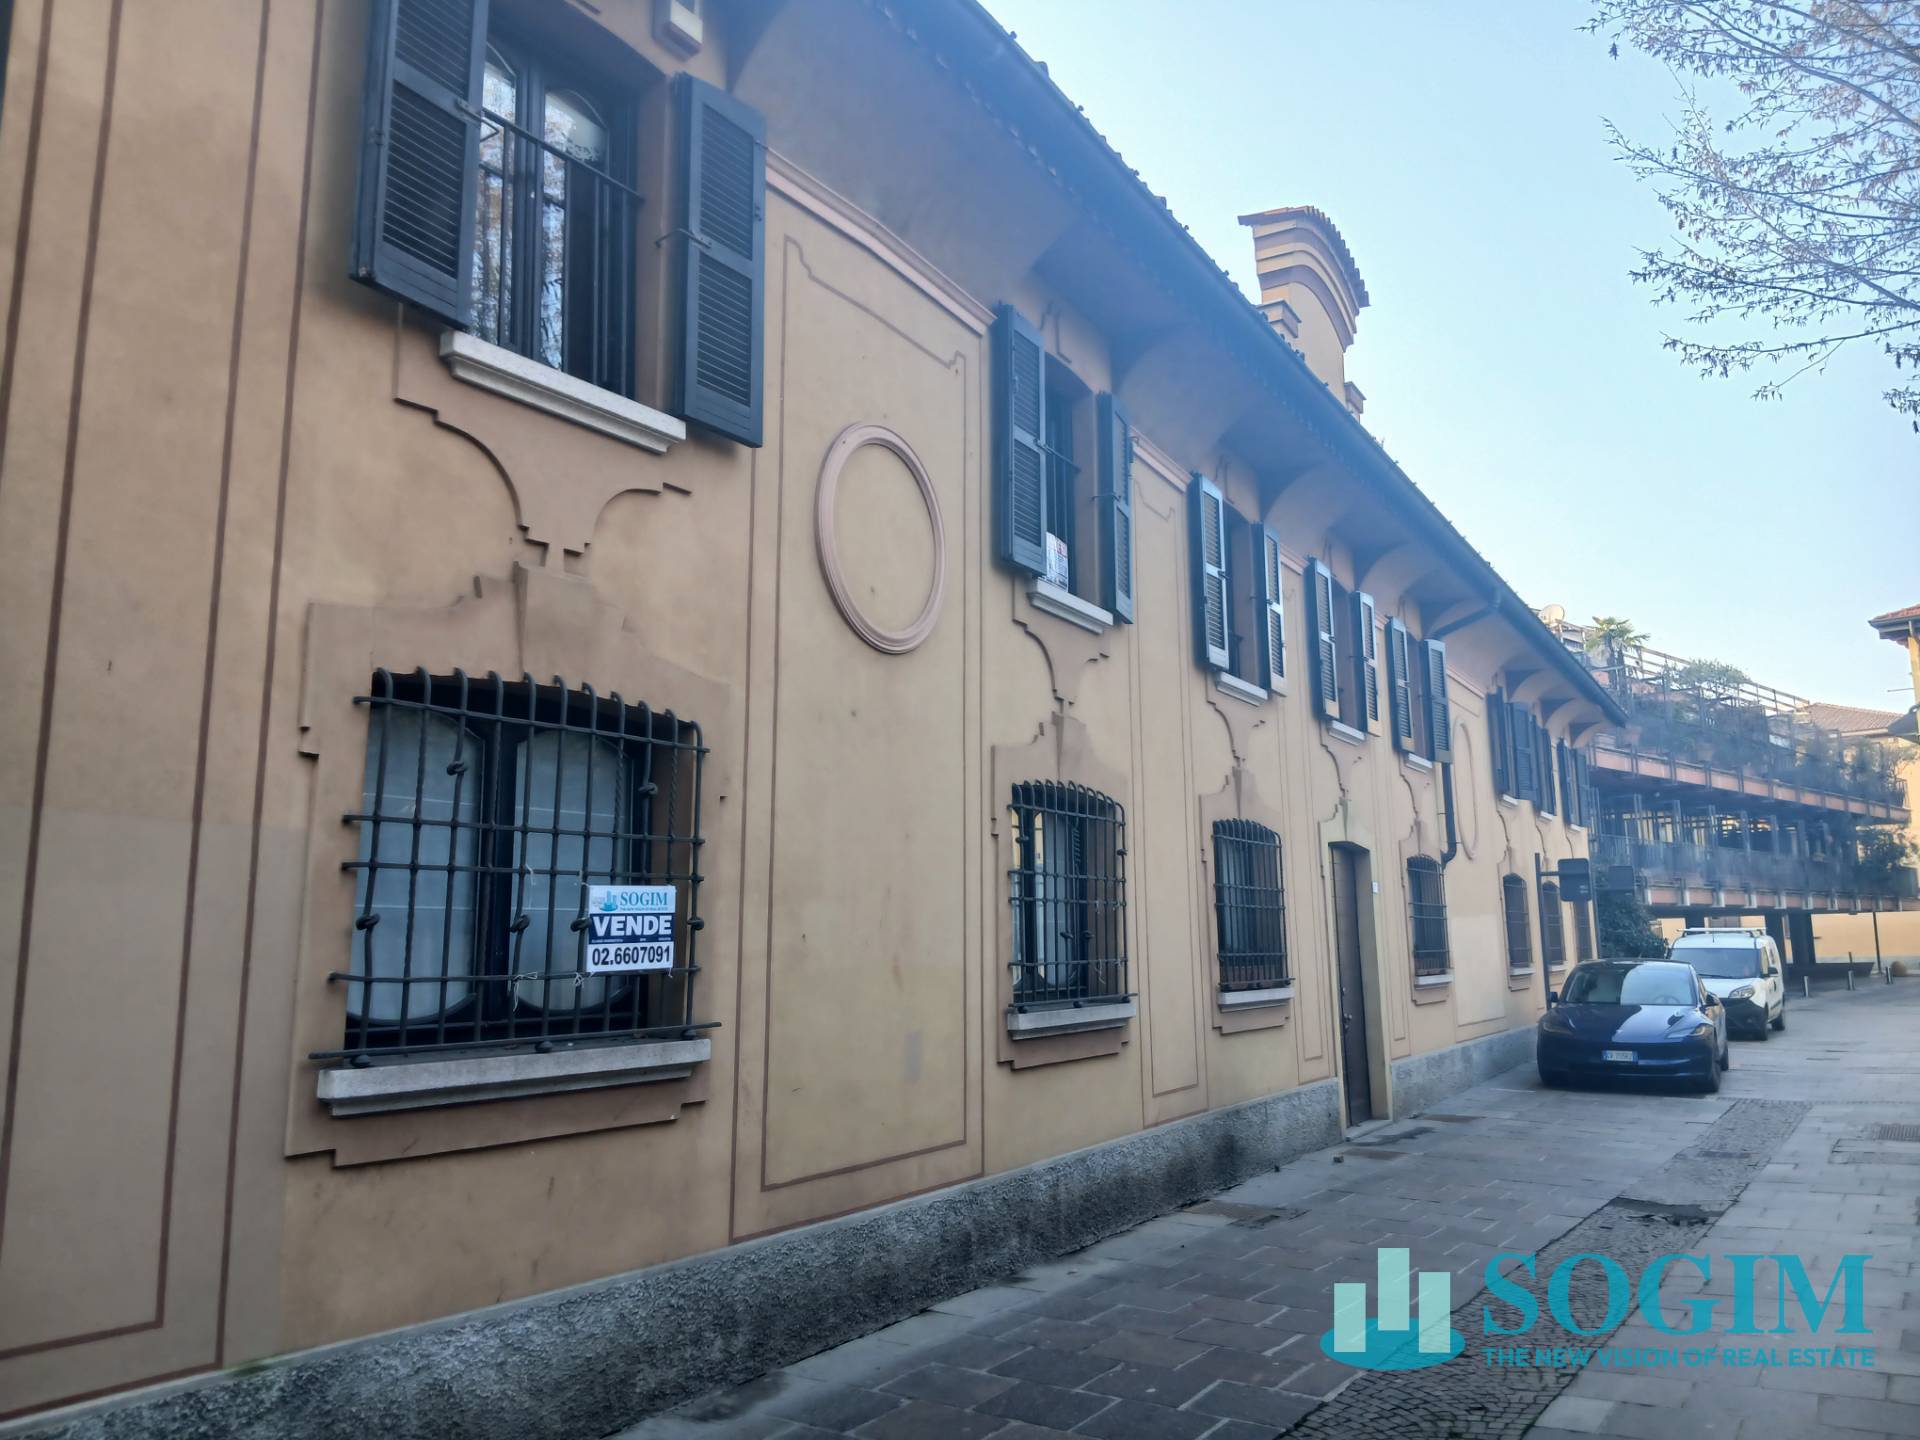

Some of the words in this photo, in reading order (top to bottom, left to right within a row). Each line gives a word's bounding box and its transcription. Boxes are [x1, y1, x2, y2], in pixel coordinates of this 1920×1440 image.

[620, 891, 668, 906] SOGIM
[592, 915, 672, 937] VENDE
[592, 945, 670, 966] 02.6607091
